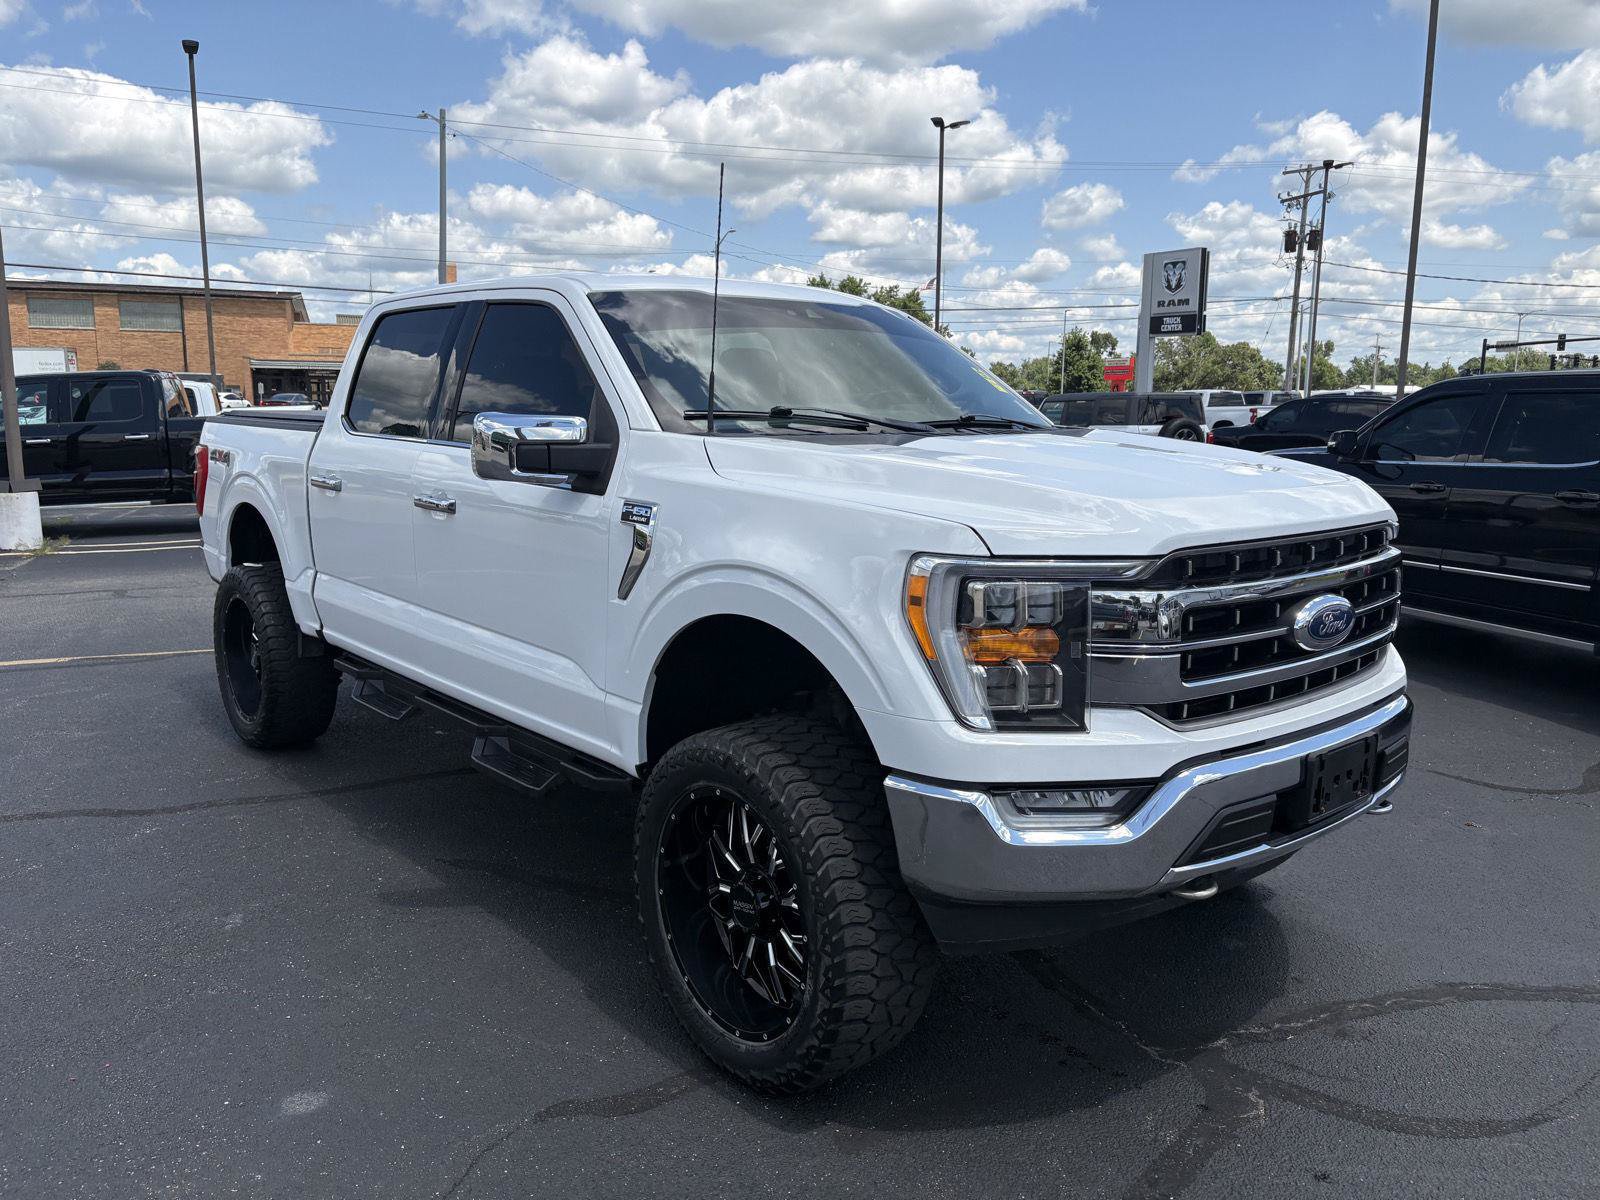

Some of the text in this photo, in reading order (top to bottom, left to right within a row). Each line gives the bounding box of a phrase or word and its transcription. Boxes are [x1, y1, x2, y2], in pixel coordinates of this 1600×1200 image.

[1157, 298, 1190, 308] RAM
[1163, 316, 1181, 325] TRUCK
[1161, 323, 1183, 332] CENTER
[622, 505, 651, 517] F-150
[1319, 610, 1347, 636] Ford
